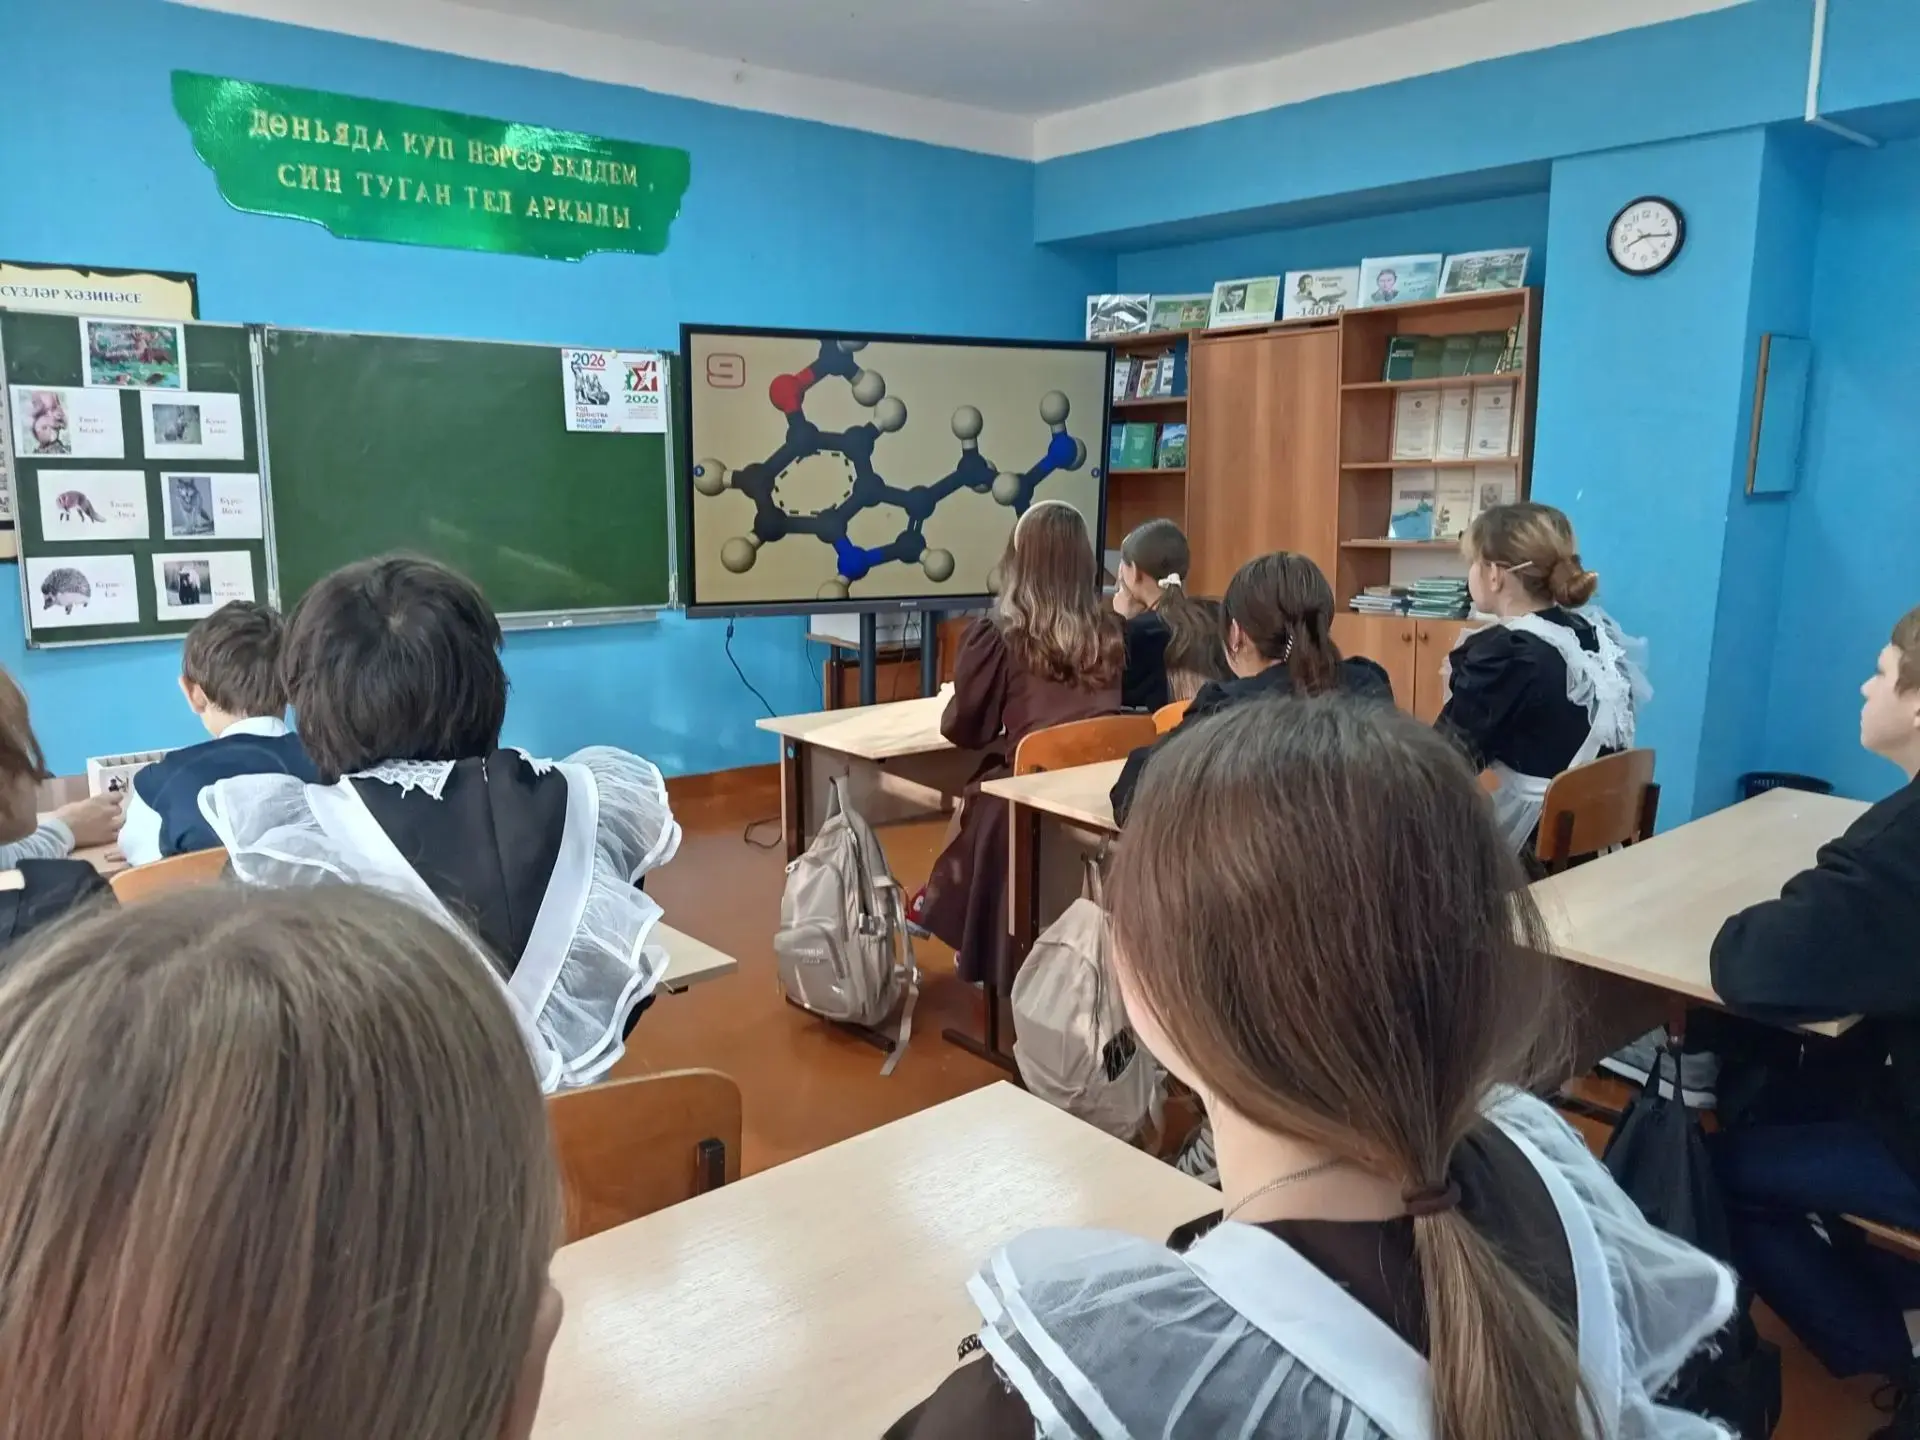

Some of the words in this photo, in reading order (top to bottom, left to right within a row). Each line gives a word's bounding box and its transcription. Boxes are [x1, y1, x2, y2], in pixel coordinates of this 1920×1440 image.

[249, 108, 390, 154] ДӨНЬЯДА
[277, 163, 343, 194] СИН
[356, 172, 451, 206] ТУГАН
[464, 186, 512, 214] ТЕЛ
[572, 352, 606, 367] 2026
[624, 393, 659, 404] 2026
